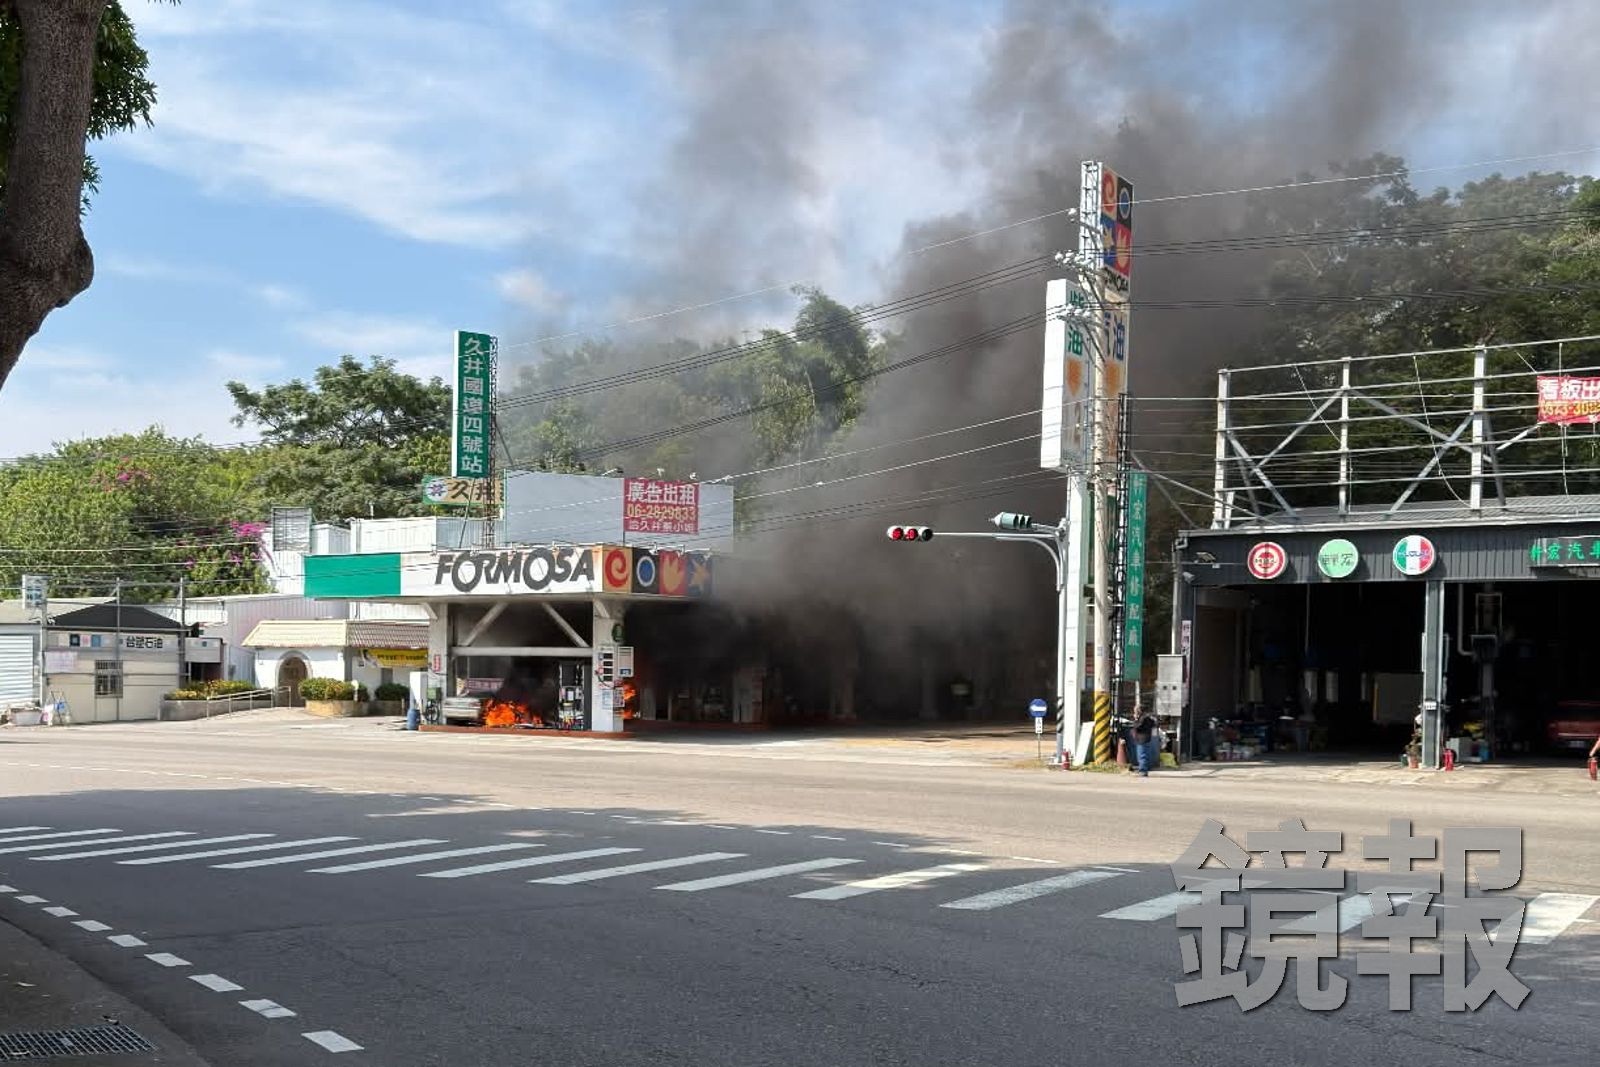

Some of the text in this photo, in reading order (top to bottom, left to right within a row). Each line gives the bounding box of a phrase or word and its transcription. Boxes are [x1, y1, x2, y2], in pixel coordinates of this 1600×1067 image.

[627, 482, 695, 505] 廣告出租
[435, 547, 595, 592] FORMOSA
[126, 635, 164, 649] 台塑石油
